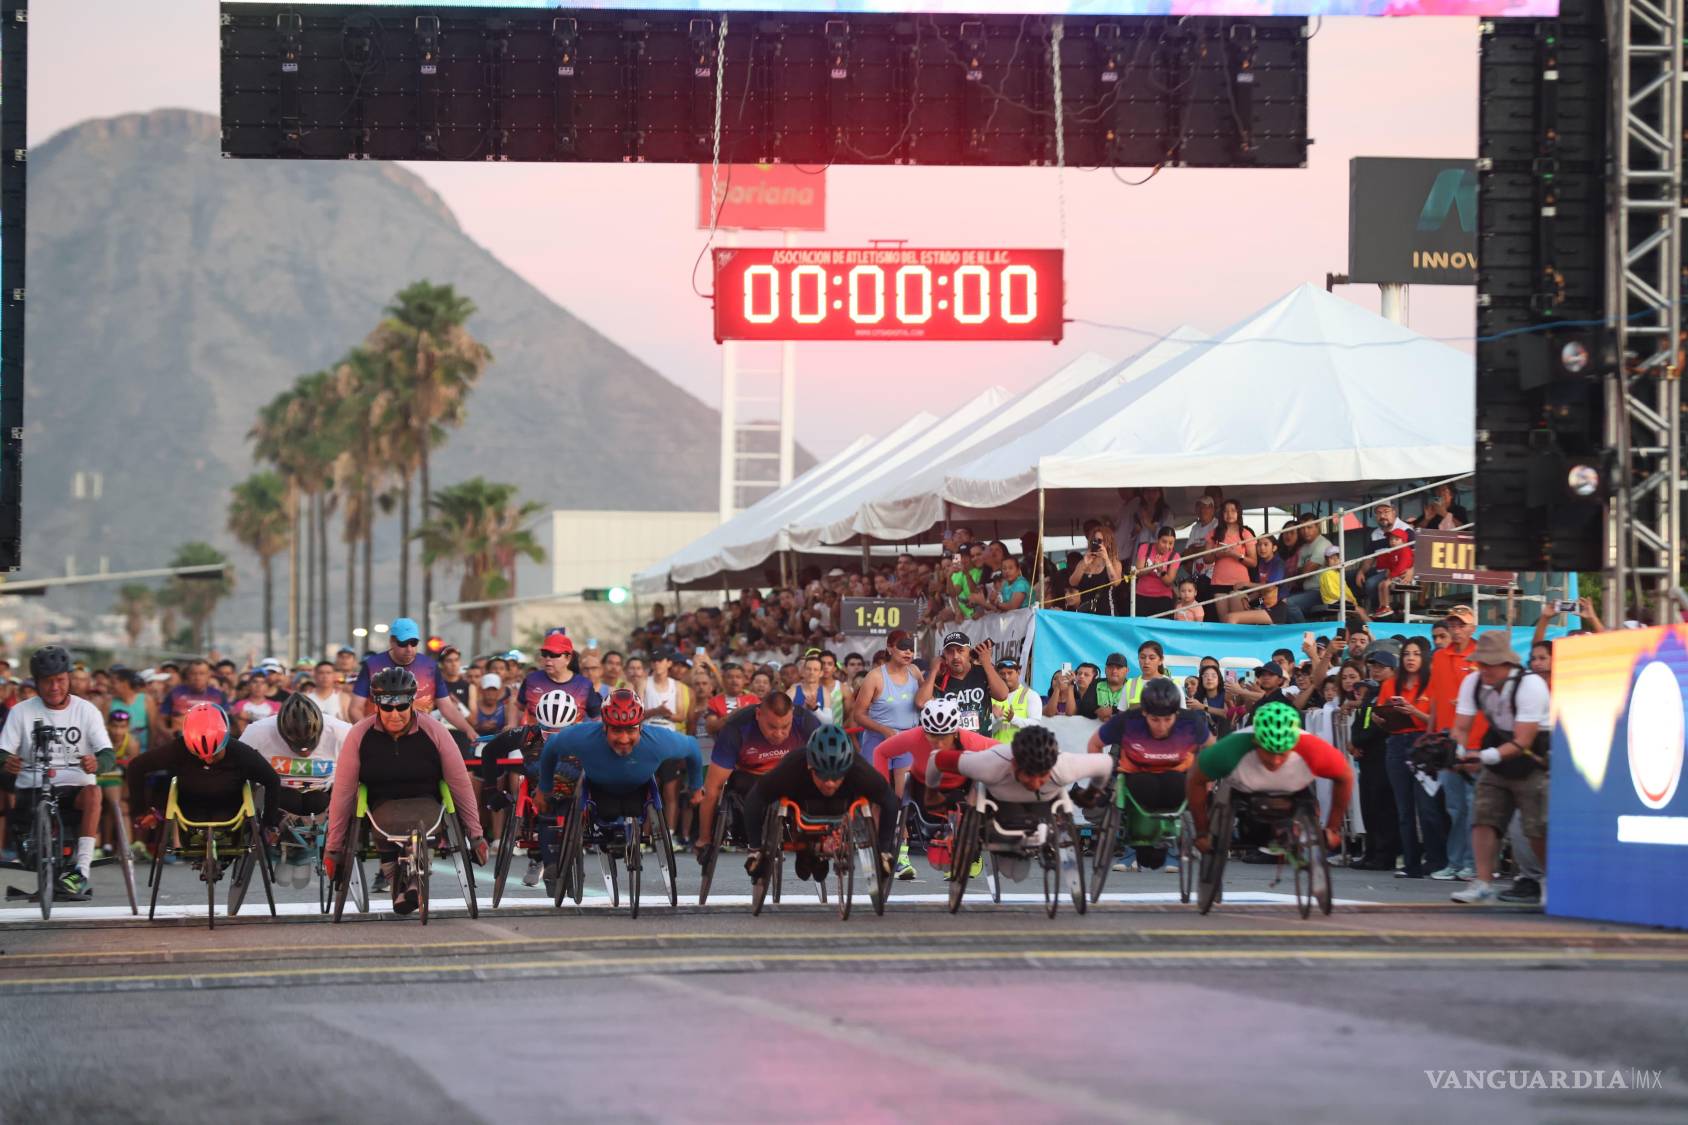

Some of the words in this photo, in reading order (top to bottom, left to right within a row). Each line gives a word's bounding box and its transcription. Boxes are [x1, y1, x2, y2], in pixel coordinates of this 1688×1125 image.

[772, 250, 831, 266] ASOCIACION
[832, 250, 845, 266] DE
[846, 250, 900, 266] ATLETISMO
[901, 250, 919, 266] DEL
[920, 250, 960, 266] ESTADO
[743, 264, 1037, 324] 00:00:00
[855, 606, 900, 627] 1:40
